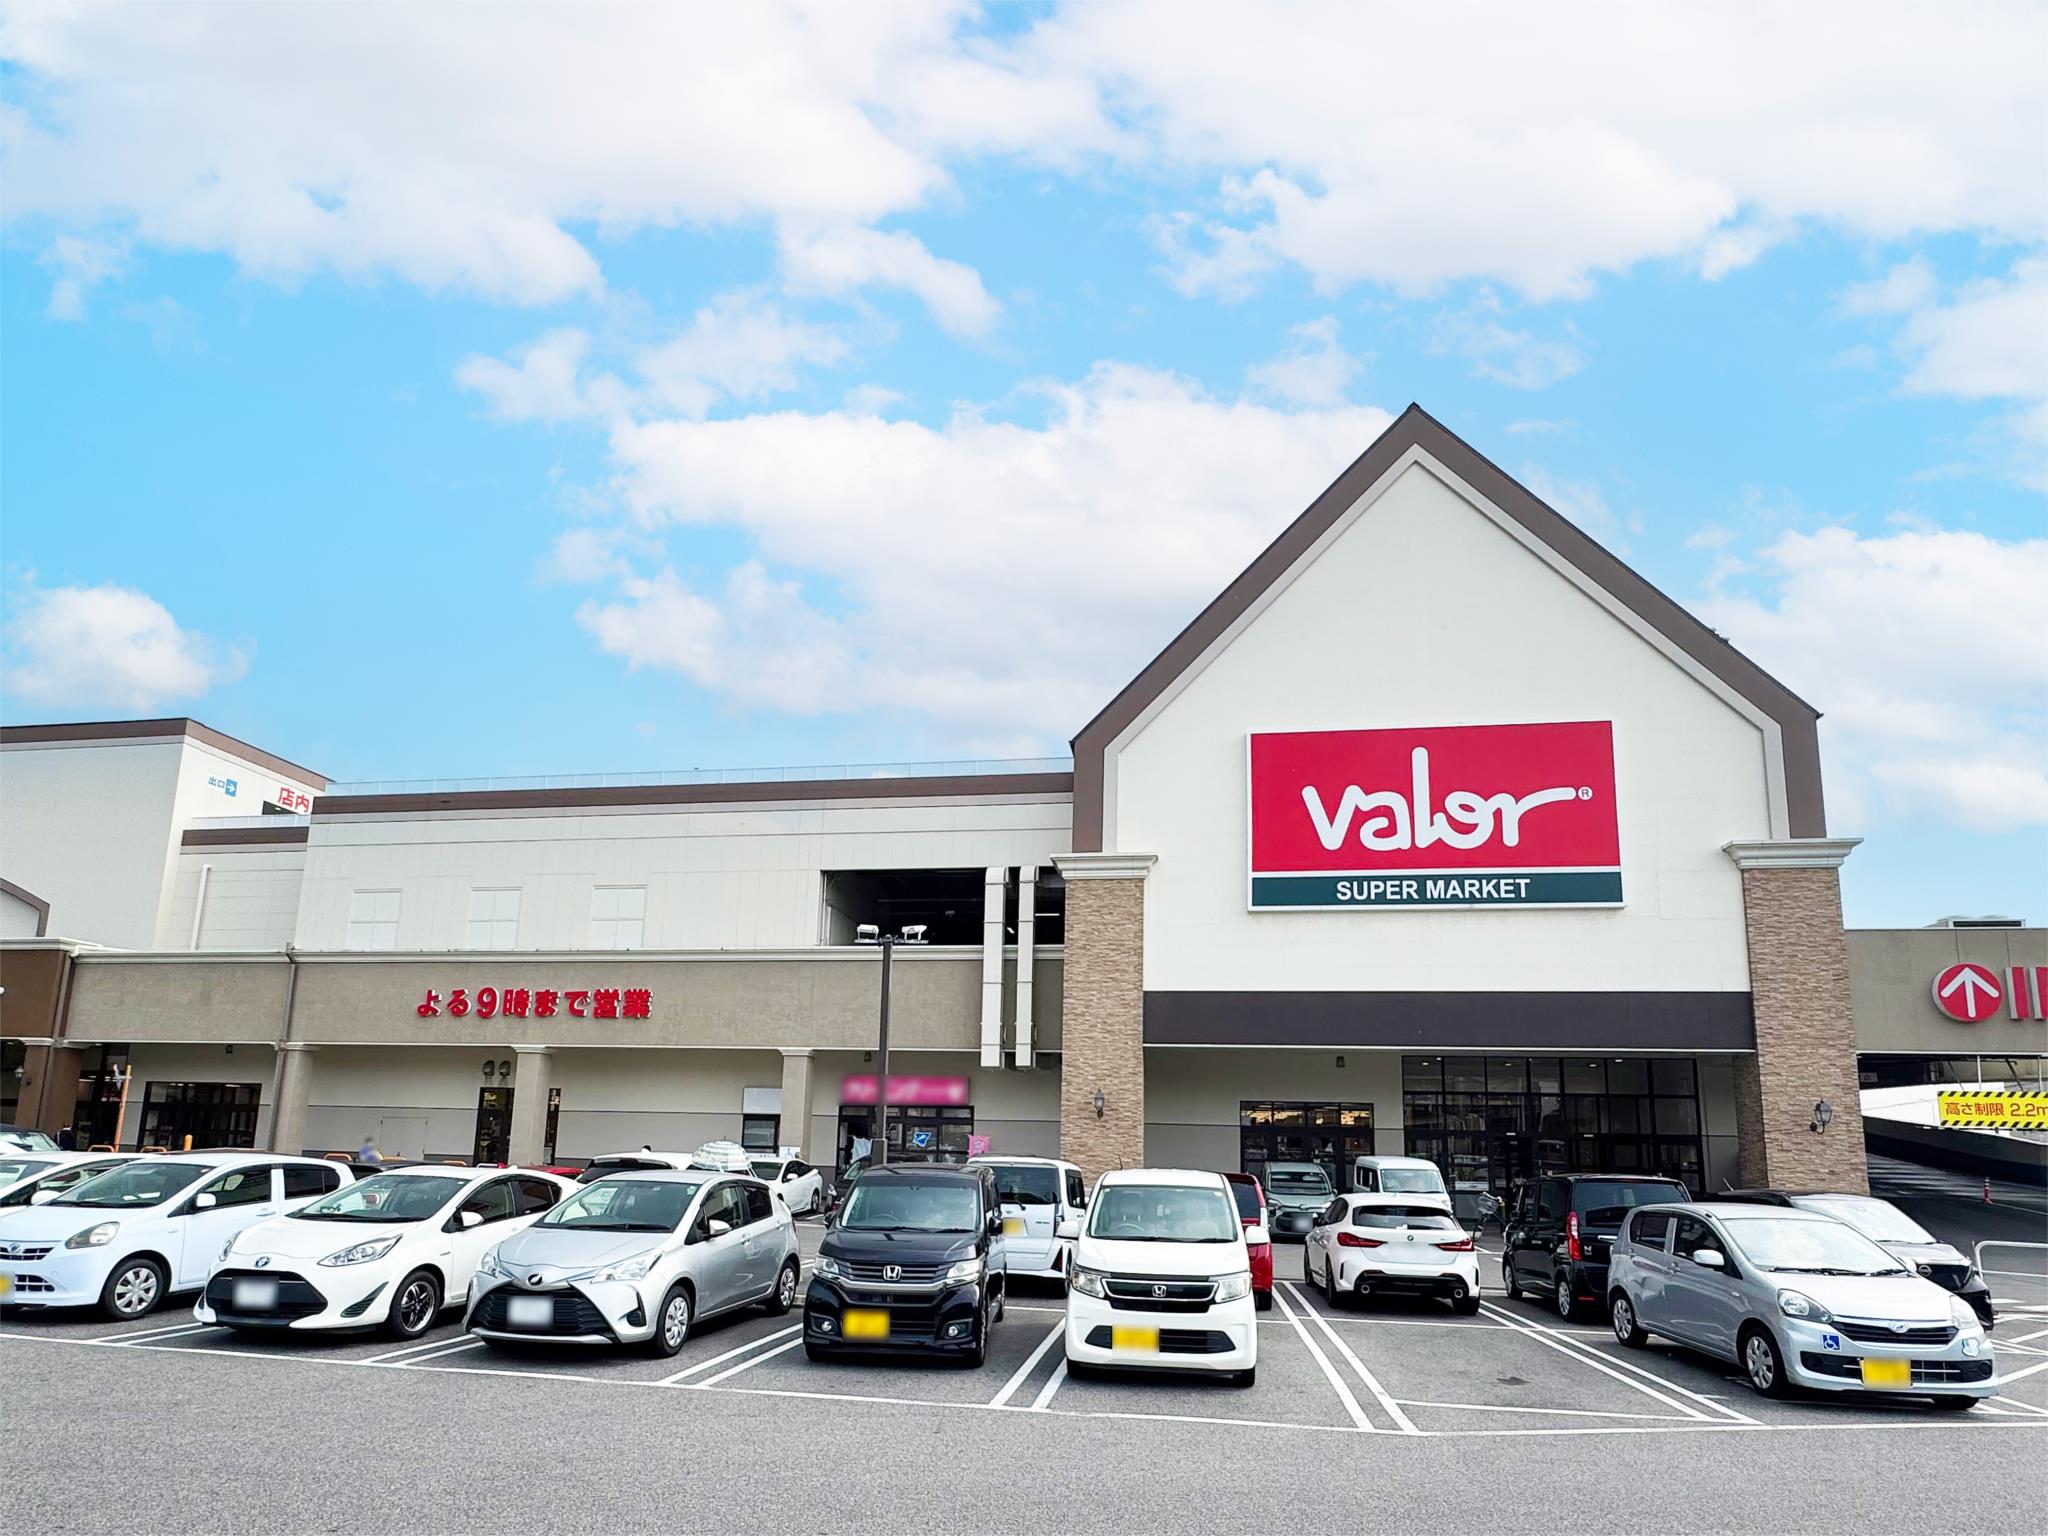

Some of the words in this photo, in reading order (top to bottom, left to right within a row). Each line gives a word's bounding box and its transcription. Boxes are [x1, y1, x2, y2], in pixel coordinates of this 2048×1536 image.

[208, 776, 226, 789] 出口
[277, 786, 310, 813] 店内
[1336, 880, 1419, 900] SUPER
[1426, 878, 1531, 899] MARKET
[416, 986, 653, 1019] よる9時まで営業
[1945, 1102, 2005, 1116] 高さ制限
